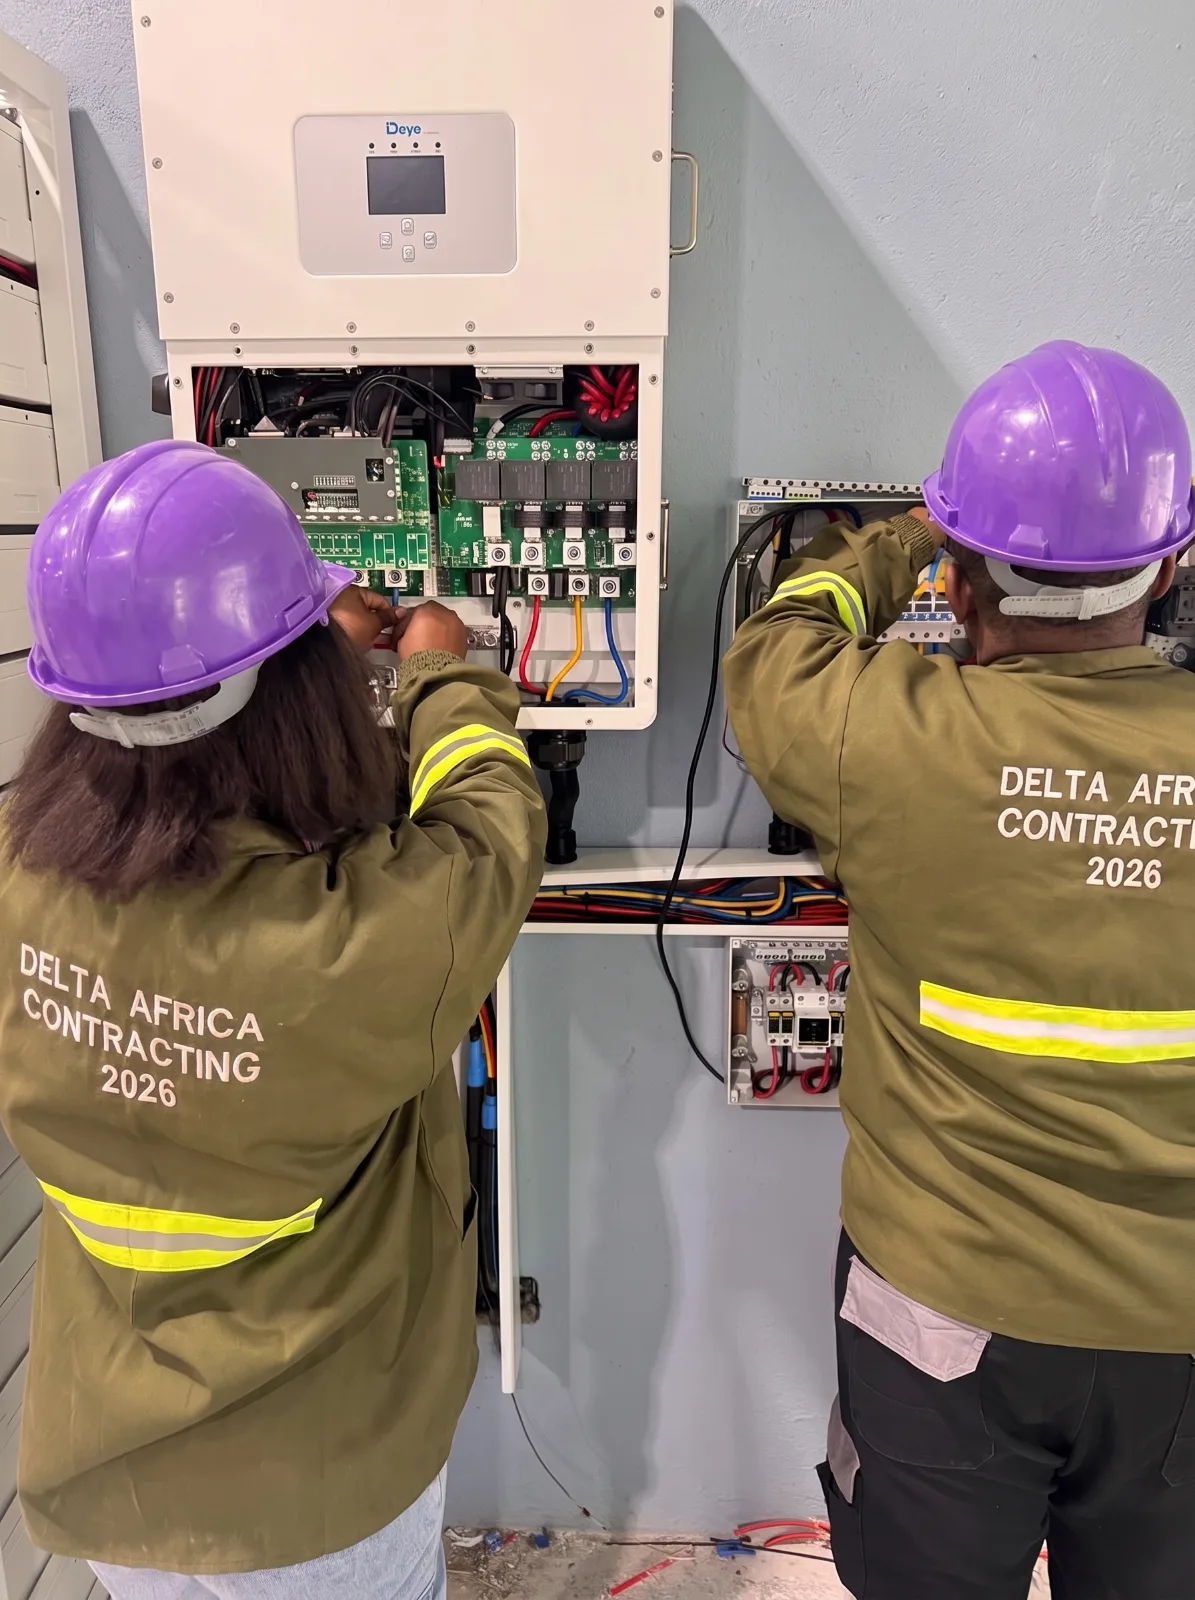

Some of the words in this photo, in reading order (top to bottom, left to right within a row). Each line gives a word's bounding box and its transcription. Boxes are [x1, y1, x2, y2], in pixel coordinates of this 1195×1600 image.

[1000, 765, 1109, 802] DELTA
[1127, 773, 1195, 806] AFR
[1086, 856, 1162, 889] 2026
[20, 942, 111, 1010] DELTA
[129, 989, 264, 1042] AFRICA
[23, 988, 261, 1083] CONTRACTING
[101, 1064, 177, 1107] 2026
